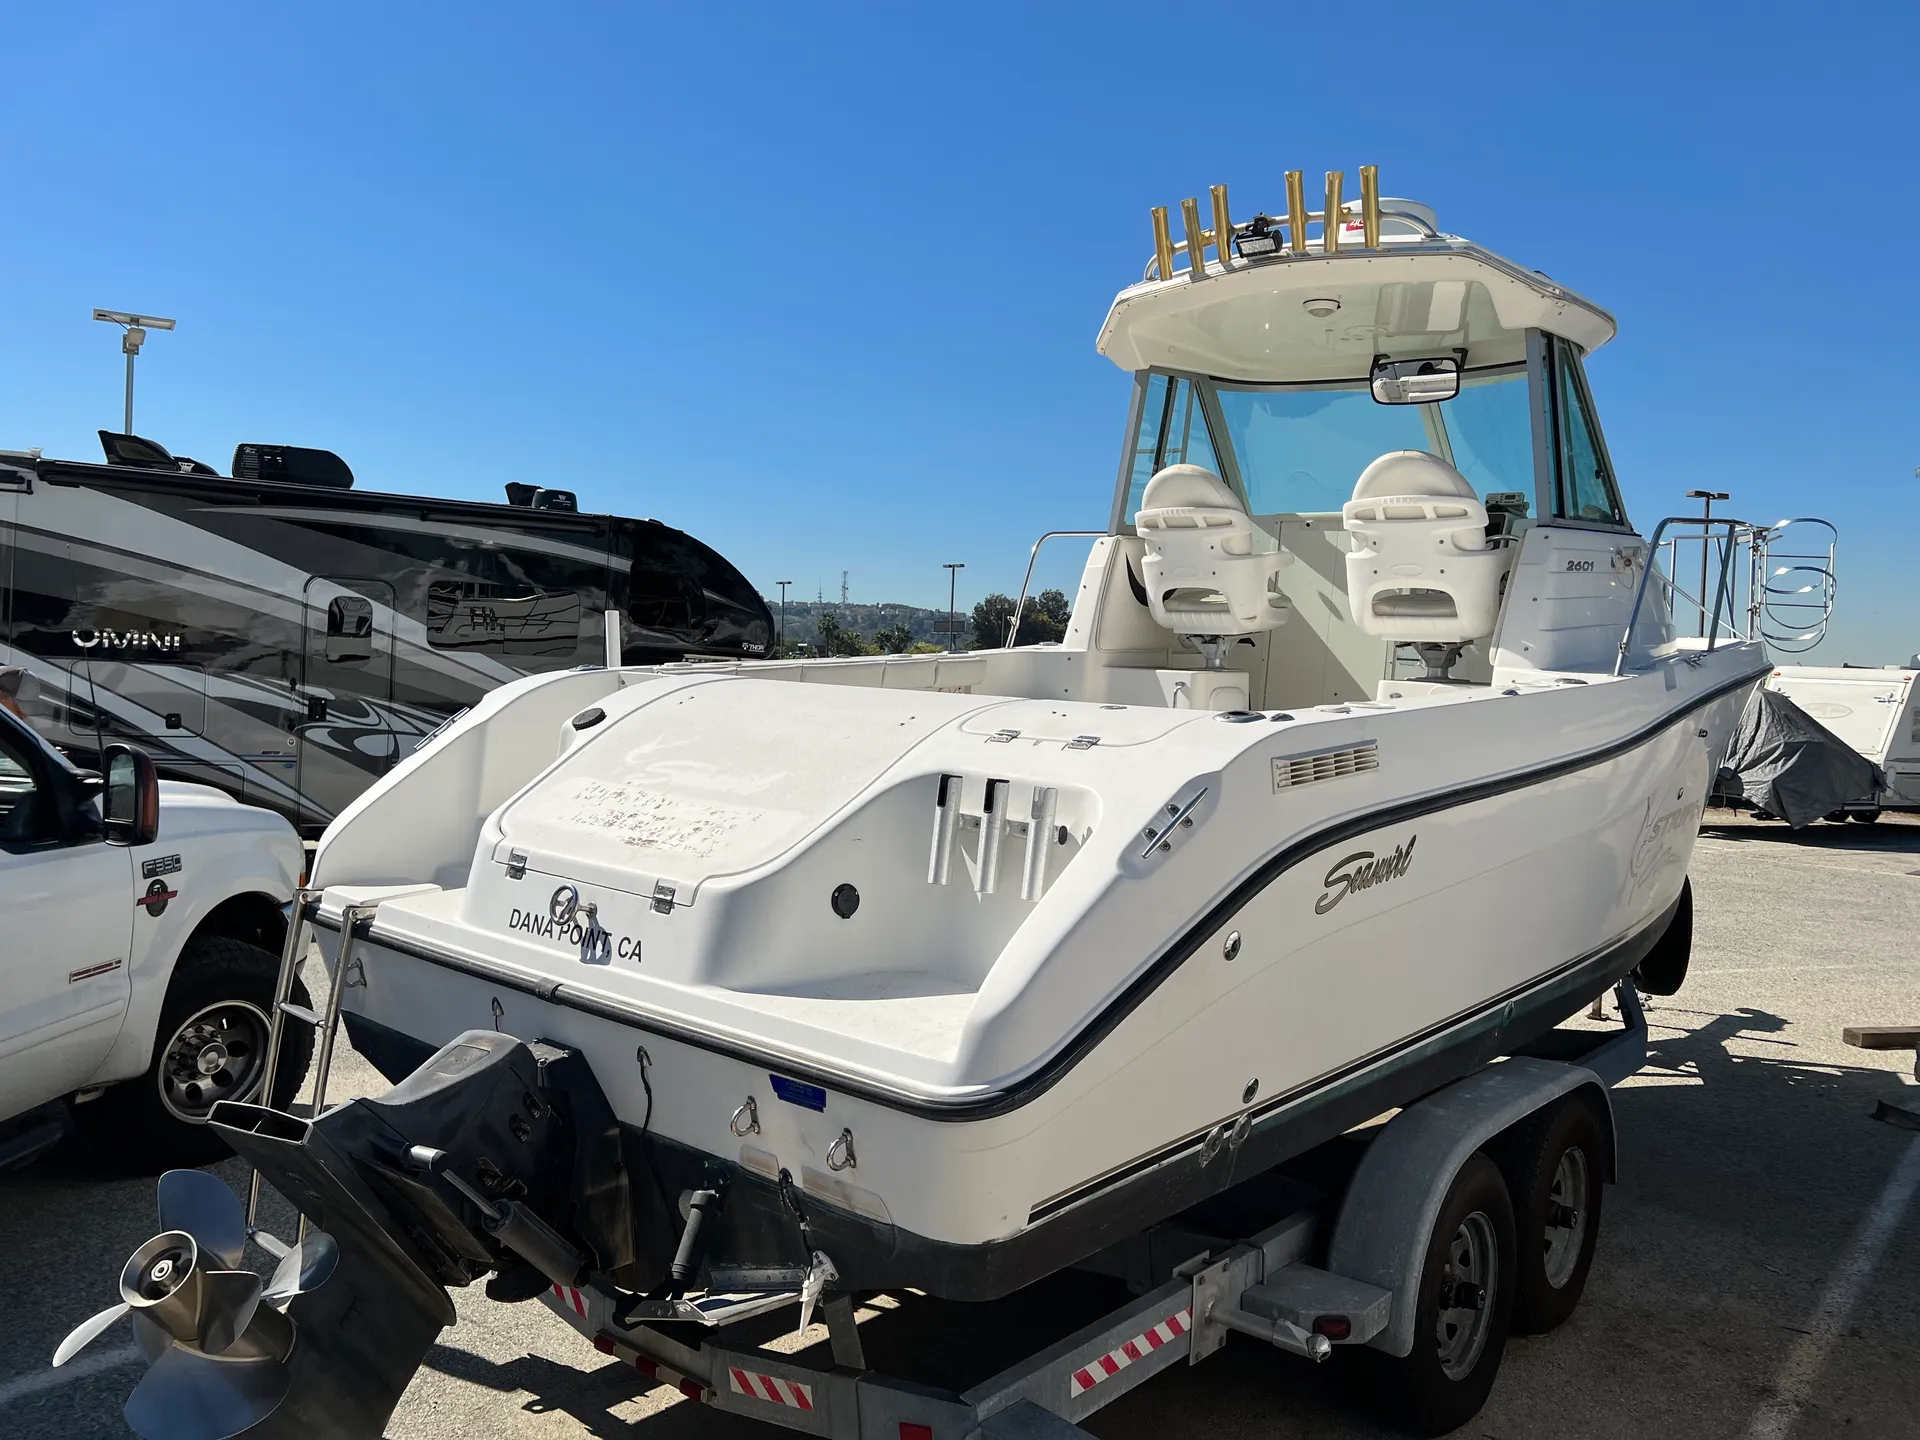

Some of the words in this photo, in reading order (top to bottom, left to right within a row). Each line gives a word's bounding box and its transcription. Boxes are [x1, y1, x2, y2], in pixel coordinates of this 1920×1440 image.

[1566, 559, 1595, 572] 2601
[71, 626, 180, 652] OMNI
[748, 643, 765, 651] THOR
[508, 907, 555, 939] DANA
[617, 936, 642, 963] CA
